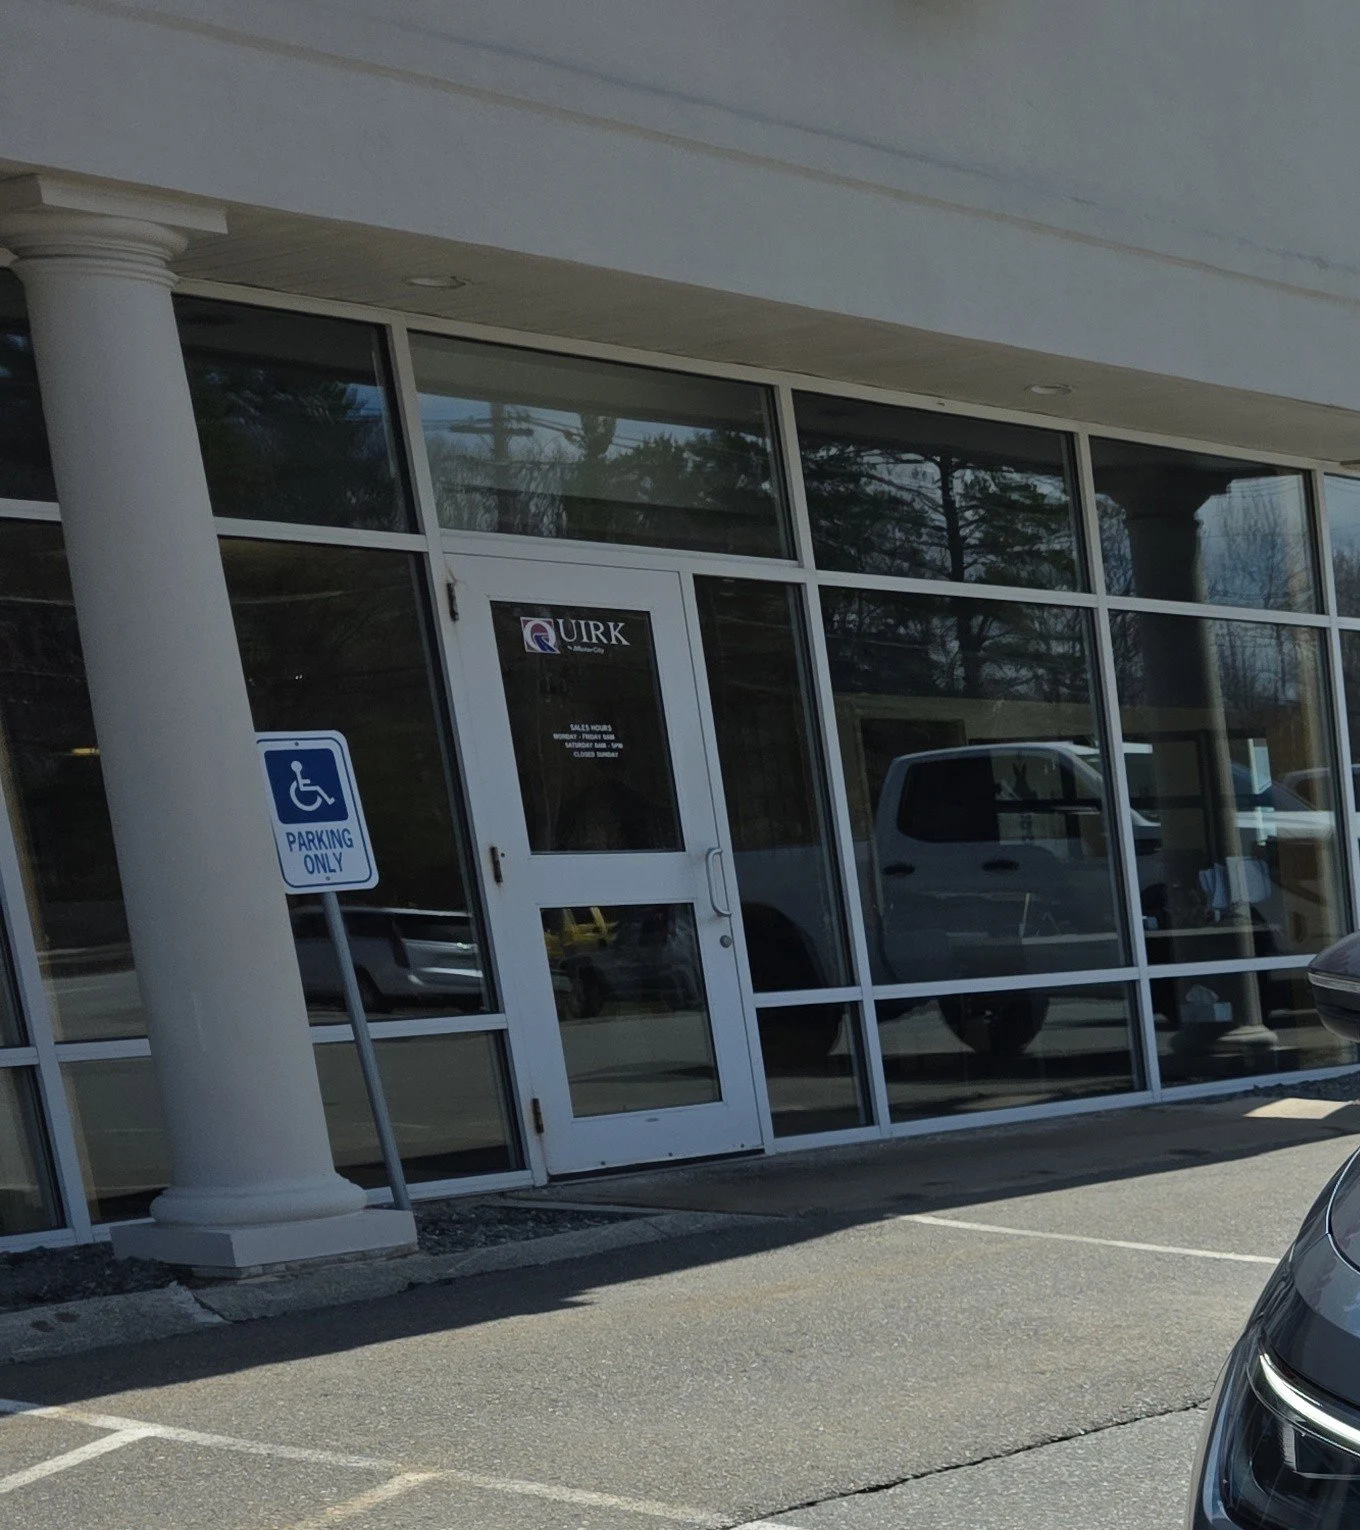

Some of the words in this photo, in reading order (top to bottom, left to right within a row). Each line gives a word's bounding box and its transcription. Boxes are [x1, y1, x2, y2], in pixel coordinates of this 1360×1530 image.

[521, 617, 630, 654] QUIRK
[286, 828, 354, 852] PARKING
[303, 852, 343, 875] ONLY
